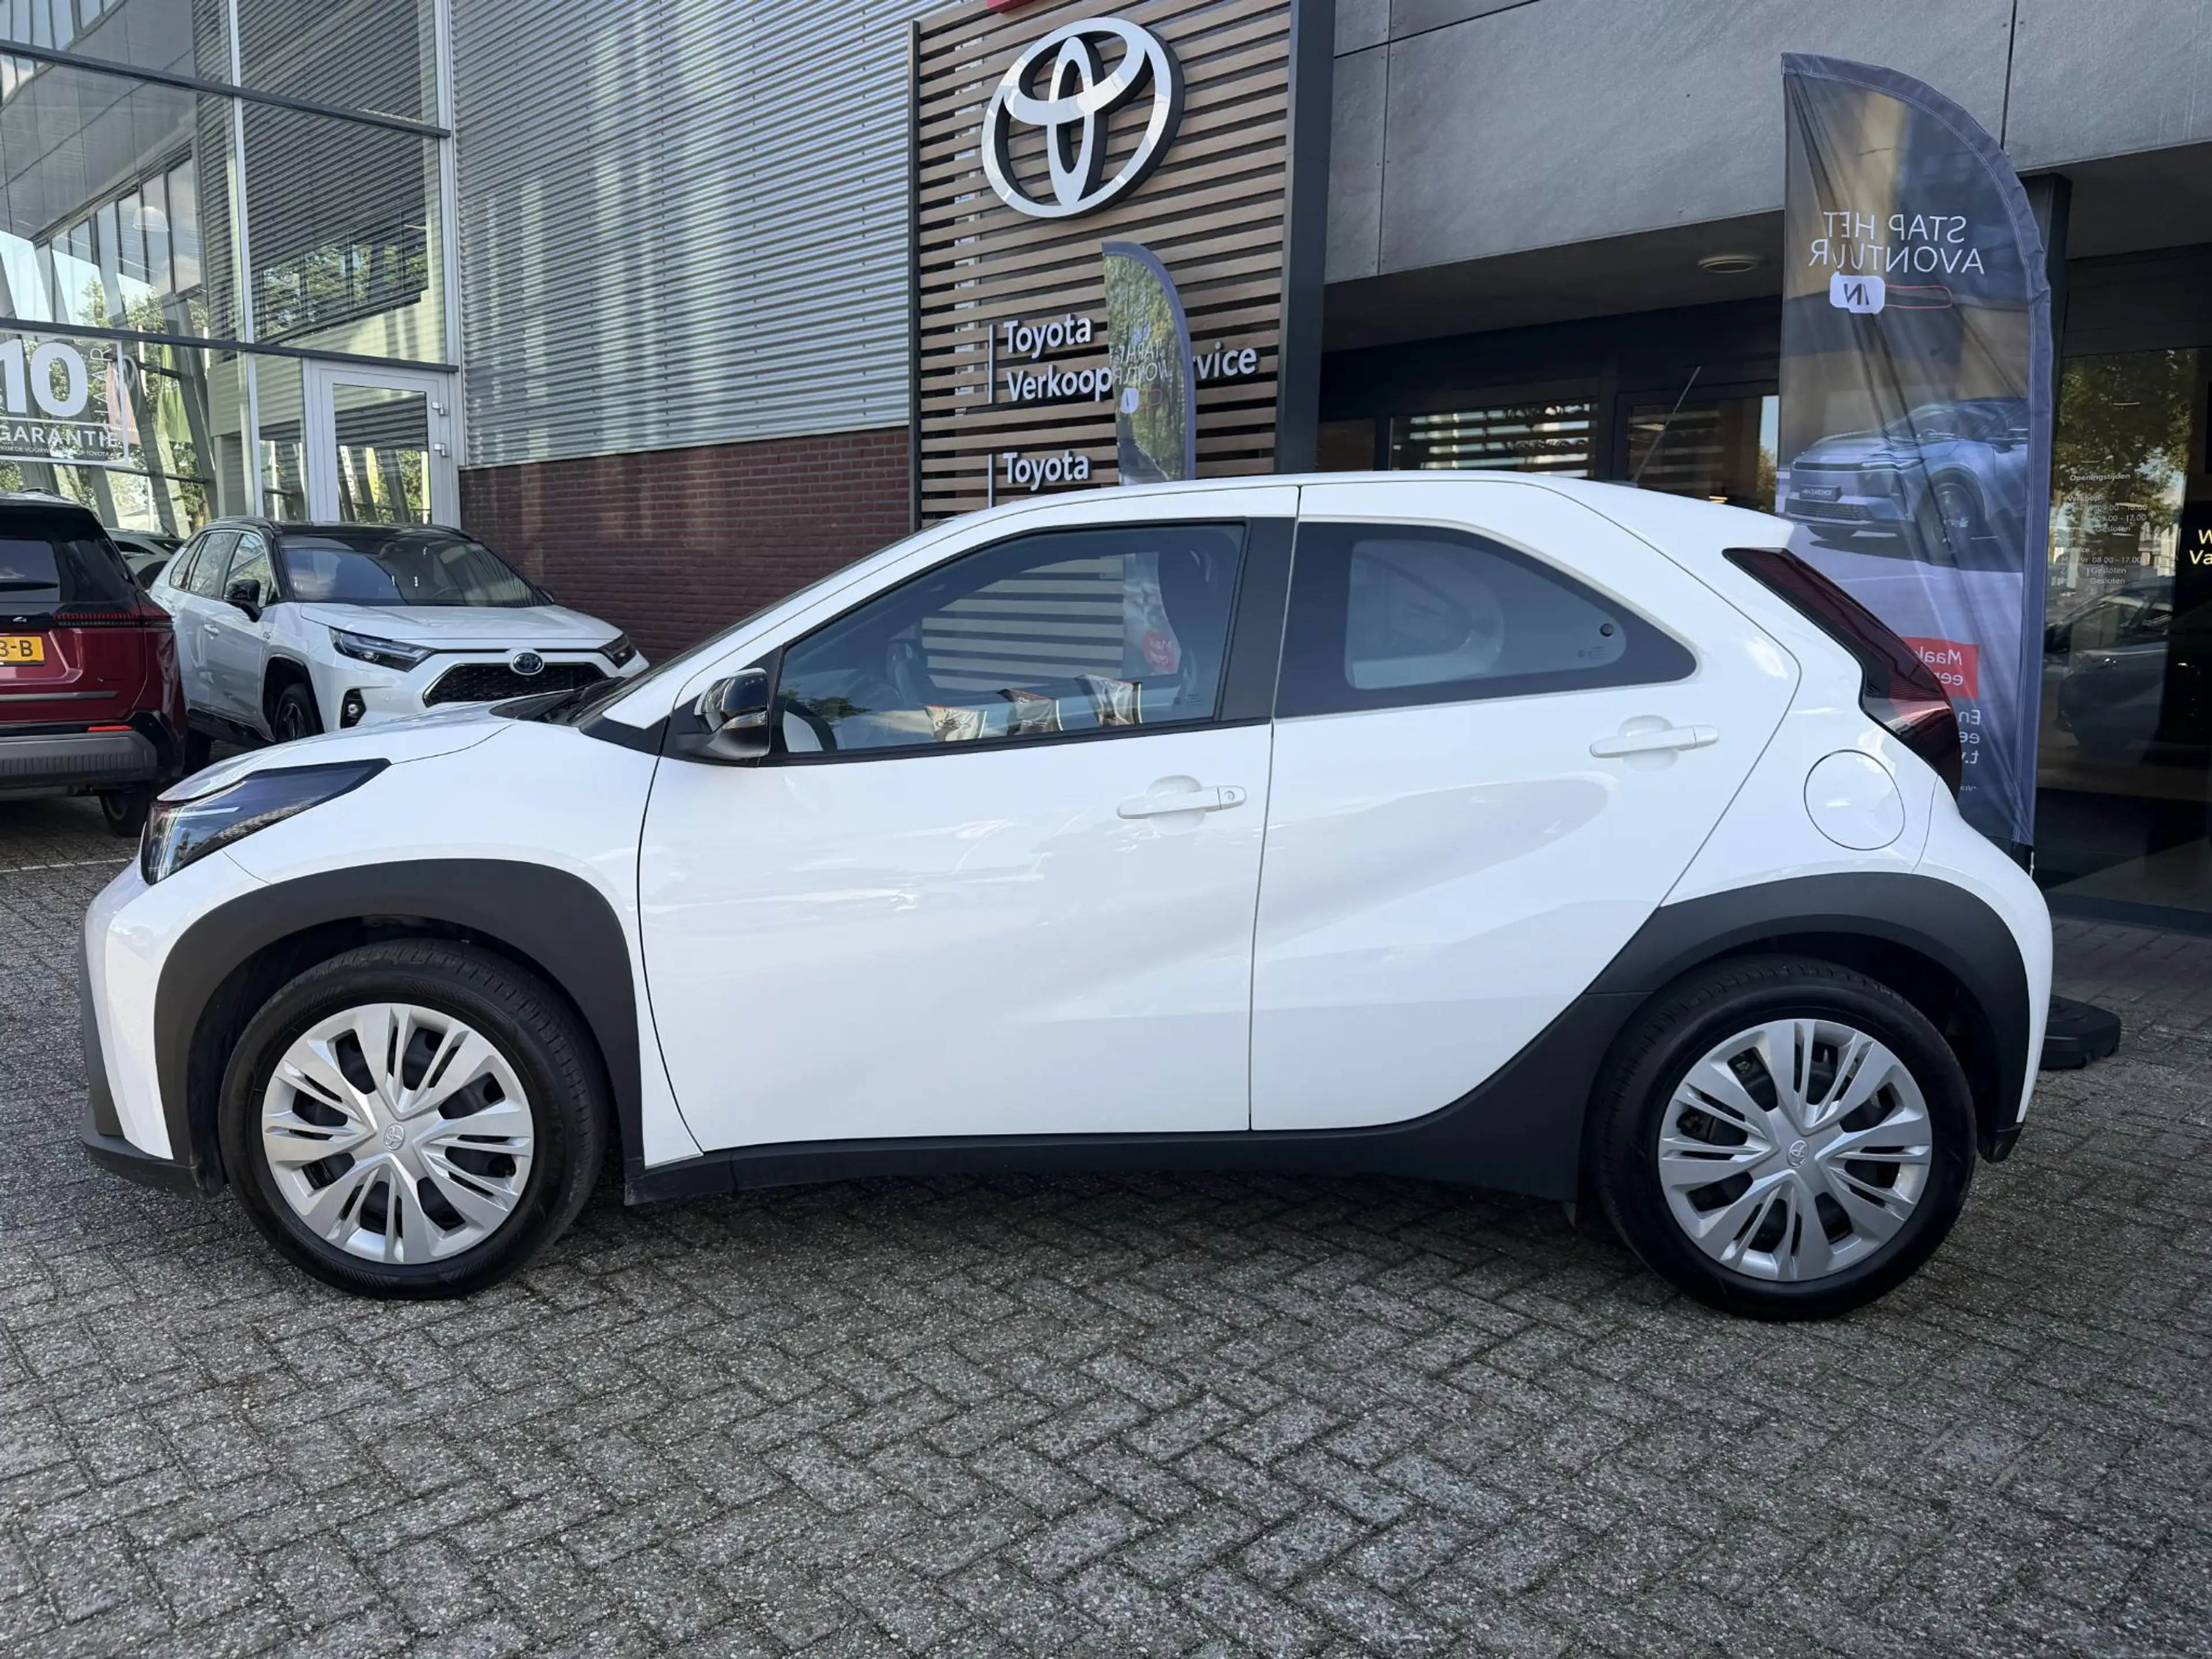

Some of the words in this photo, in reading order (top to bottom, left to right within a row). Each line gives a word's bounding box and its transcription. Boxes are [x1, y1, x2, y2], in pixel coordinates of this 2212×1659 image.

[1003, 314, 1092, 358] Toyota
[0, 339, 88, 416] 10
[1006, 364, 1112, 402] Verkoop
[1192, 341, 1257, 379] vice
[1003, 450, 1089, 491] Toyota
[2069, 472, 2131, 482] Openingstijden
